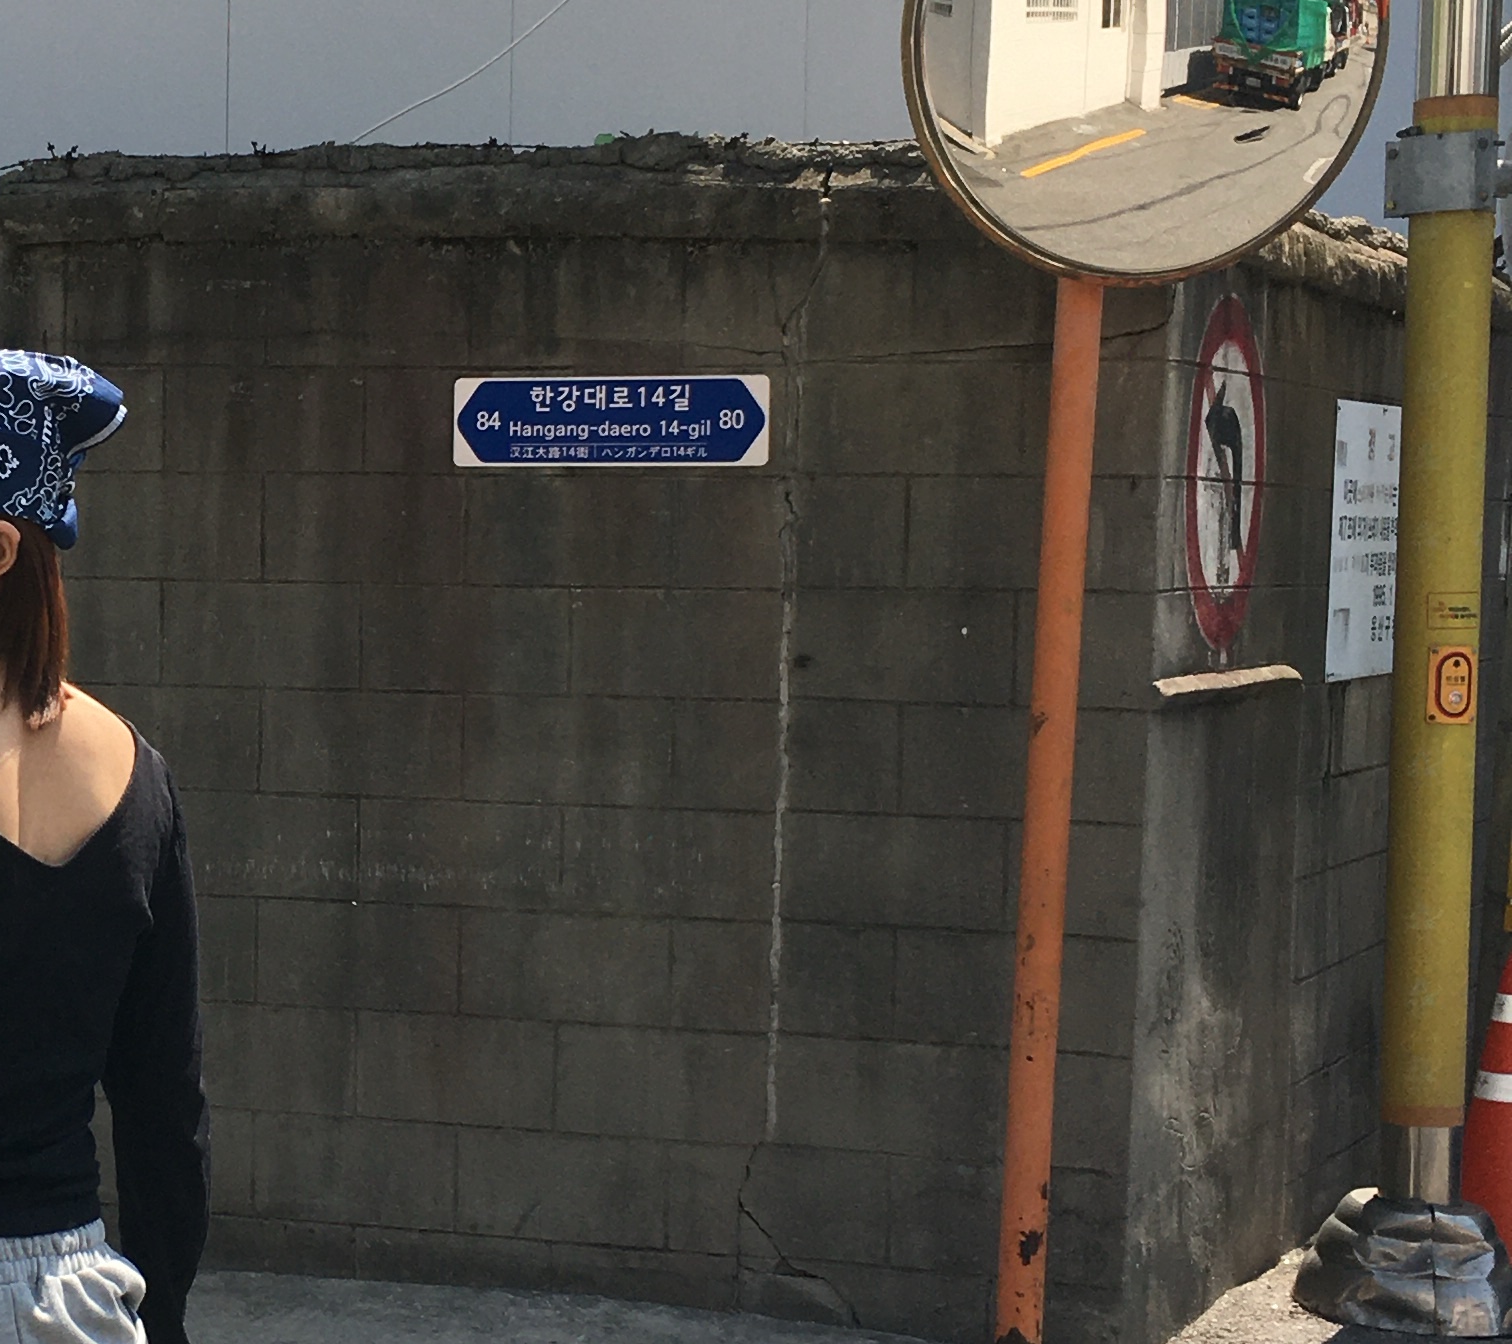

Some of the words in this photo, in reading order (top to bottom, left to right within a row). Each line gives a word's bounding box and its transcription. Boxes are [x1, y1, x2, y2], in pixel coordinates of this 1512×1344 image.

[530, 384, 690, 412] 한강대로14길
[476, 411, 501, 431] 84
[509, 420, 651, 441] Hangang-daero
[659, 419, 711, 440] 14-gil
[719, 409, 744, 430] 80
[601, 446, 708, 458] ハンガンデロ14ギル
